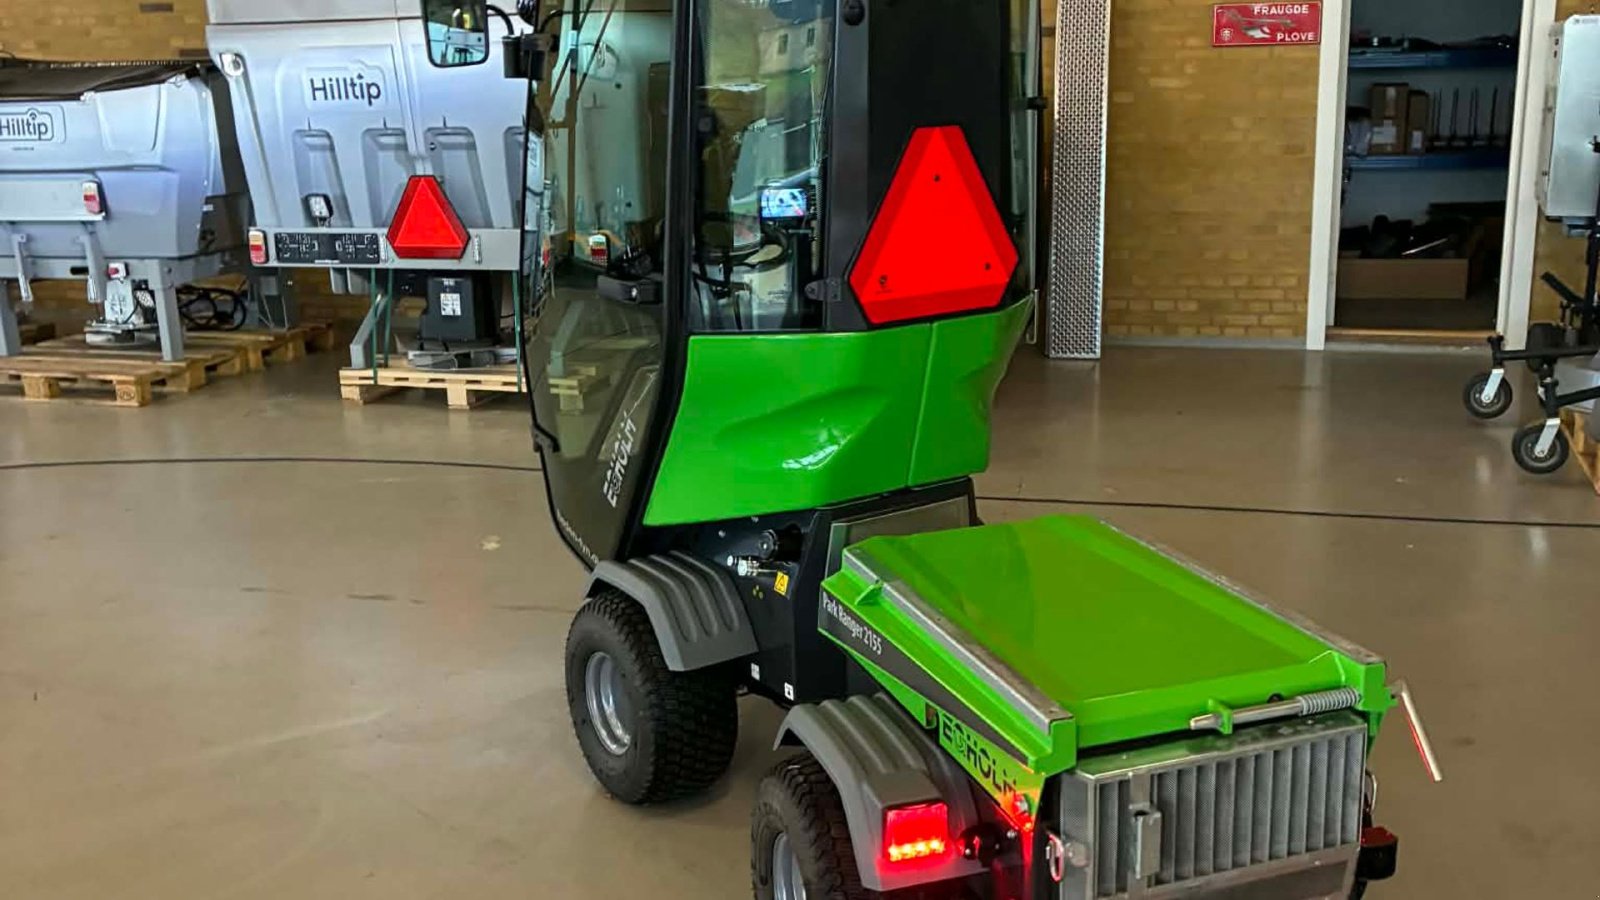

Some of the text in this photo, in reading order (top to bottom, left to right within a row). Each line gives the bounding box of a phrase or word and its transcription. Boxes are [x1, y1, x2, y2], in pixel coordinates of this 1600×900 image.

[1253, 4, 1310, 16] FRAUGDE
[1276, 31, 1315, 42] PLOVE
[309, 73, 381, 107] Hilltip
[0, 115, 49, 141] Hilltip
[822, 591, 882, 655] Park Ranger 2155
